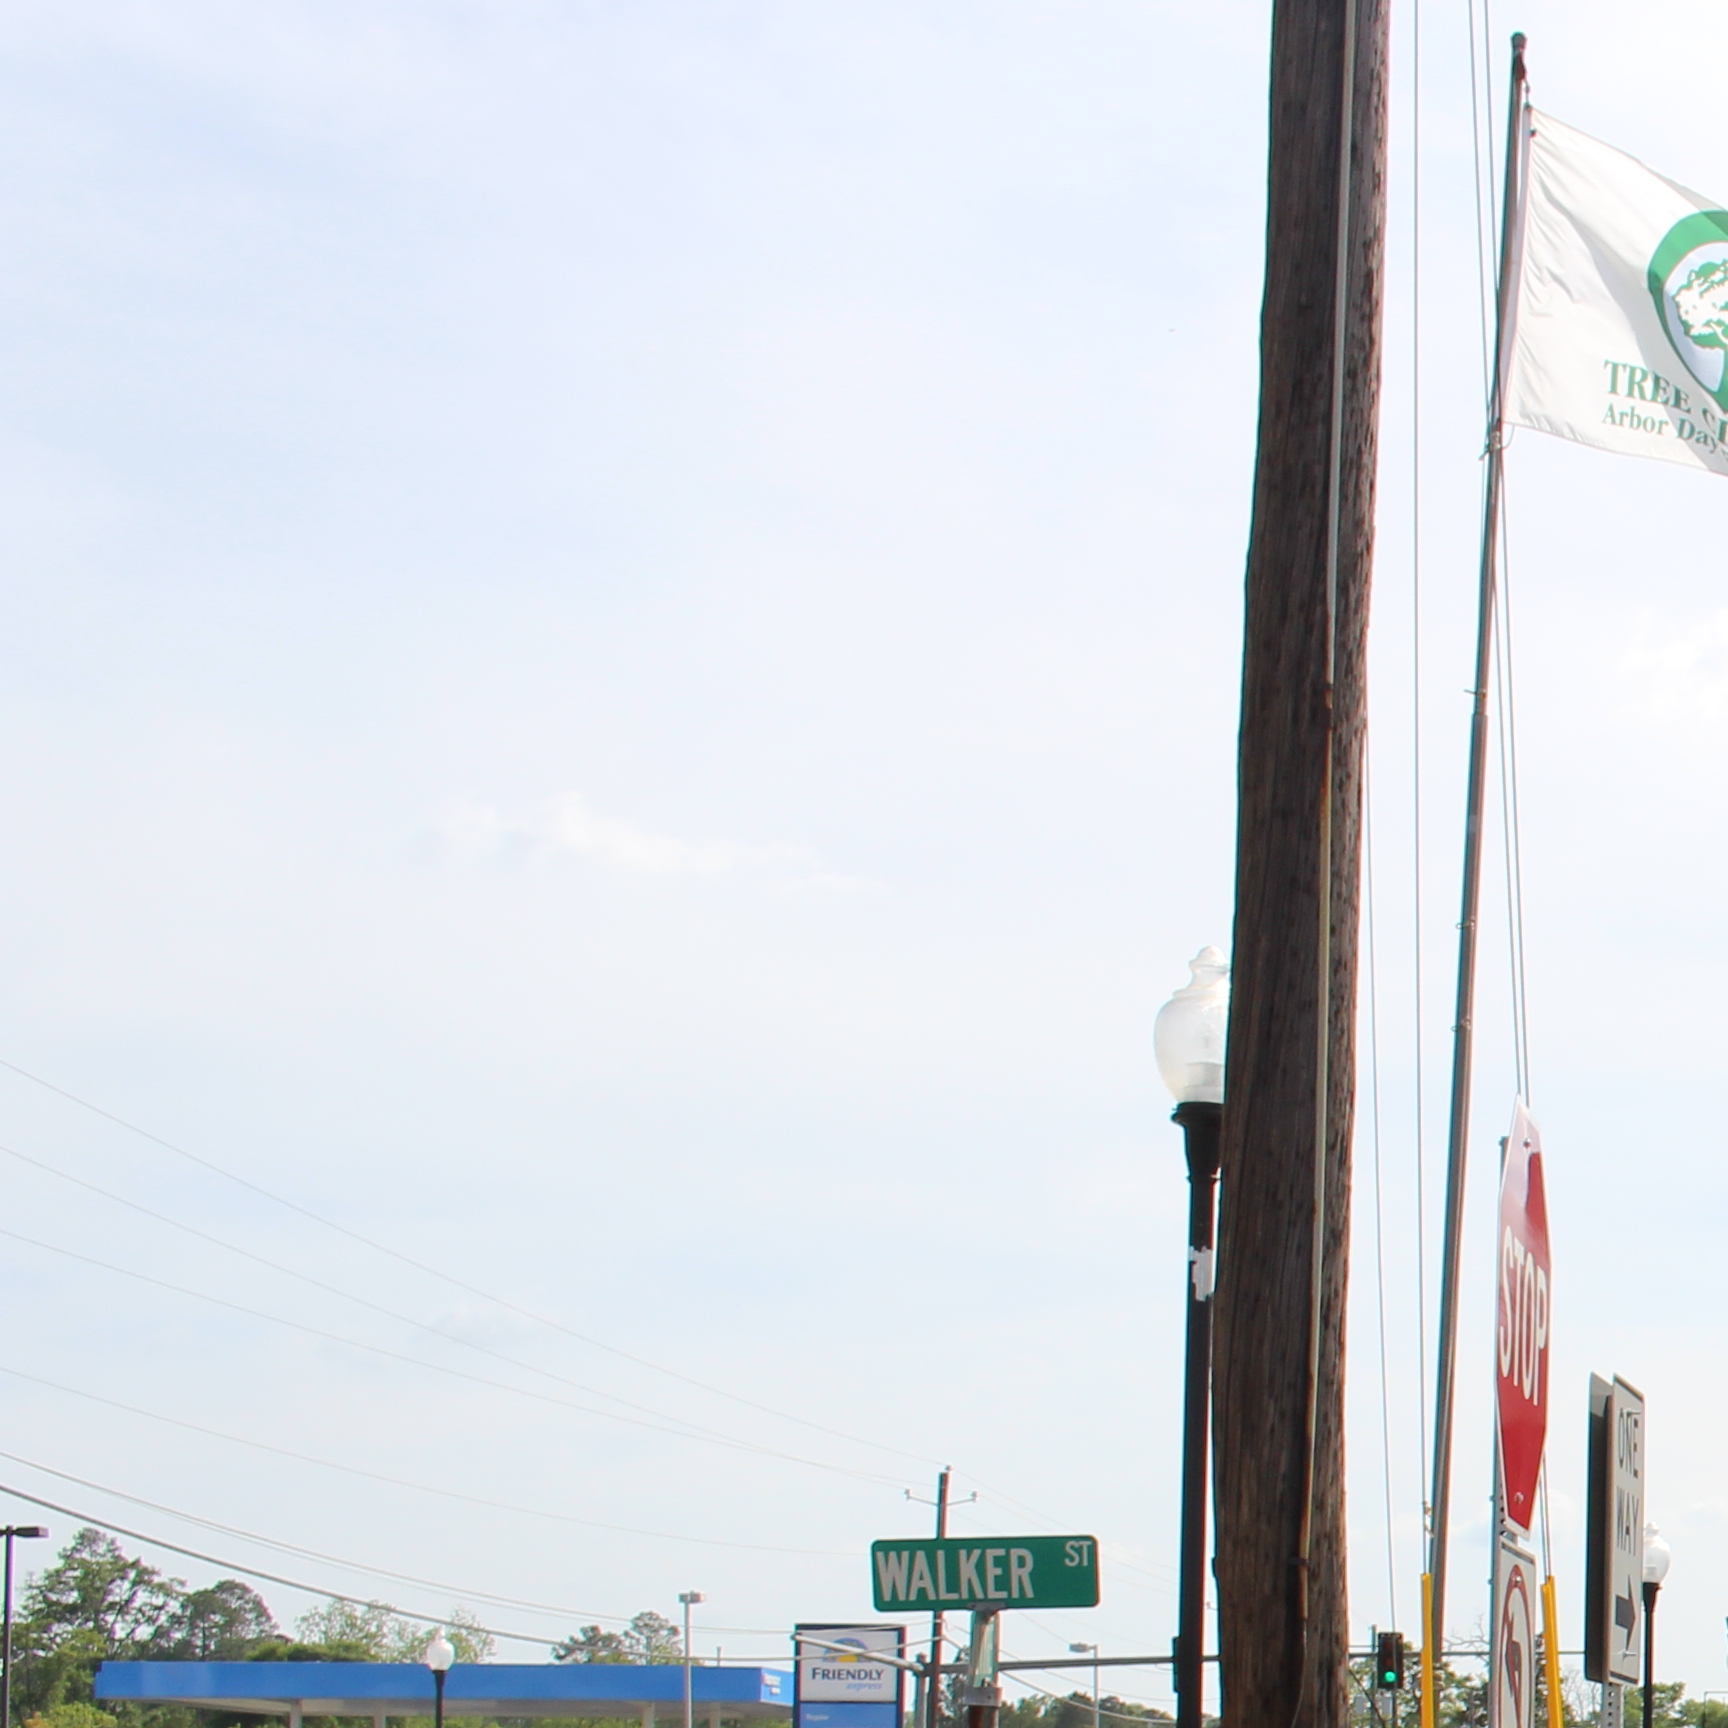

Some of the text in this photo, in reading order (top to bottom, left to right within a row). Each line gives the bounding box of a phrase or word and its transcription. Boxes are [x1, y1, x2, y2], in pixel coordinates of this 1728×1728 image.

[1604, 359, 1692, 414] TREE
[1601, 402, 1670, 436] Arbor
[1675, 417, 1719, 454] Day
[1500, 1225, 1548, 1406] STOP
[1618, 1407, 1640, 1480] ONE
[1616, 1486, 1640, 1557] WAY
[875, 1540, 1093, 1602] WALKER ST
[811, 1667, 885, 1681] FRIENDLY
